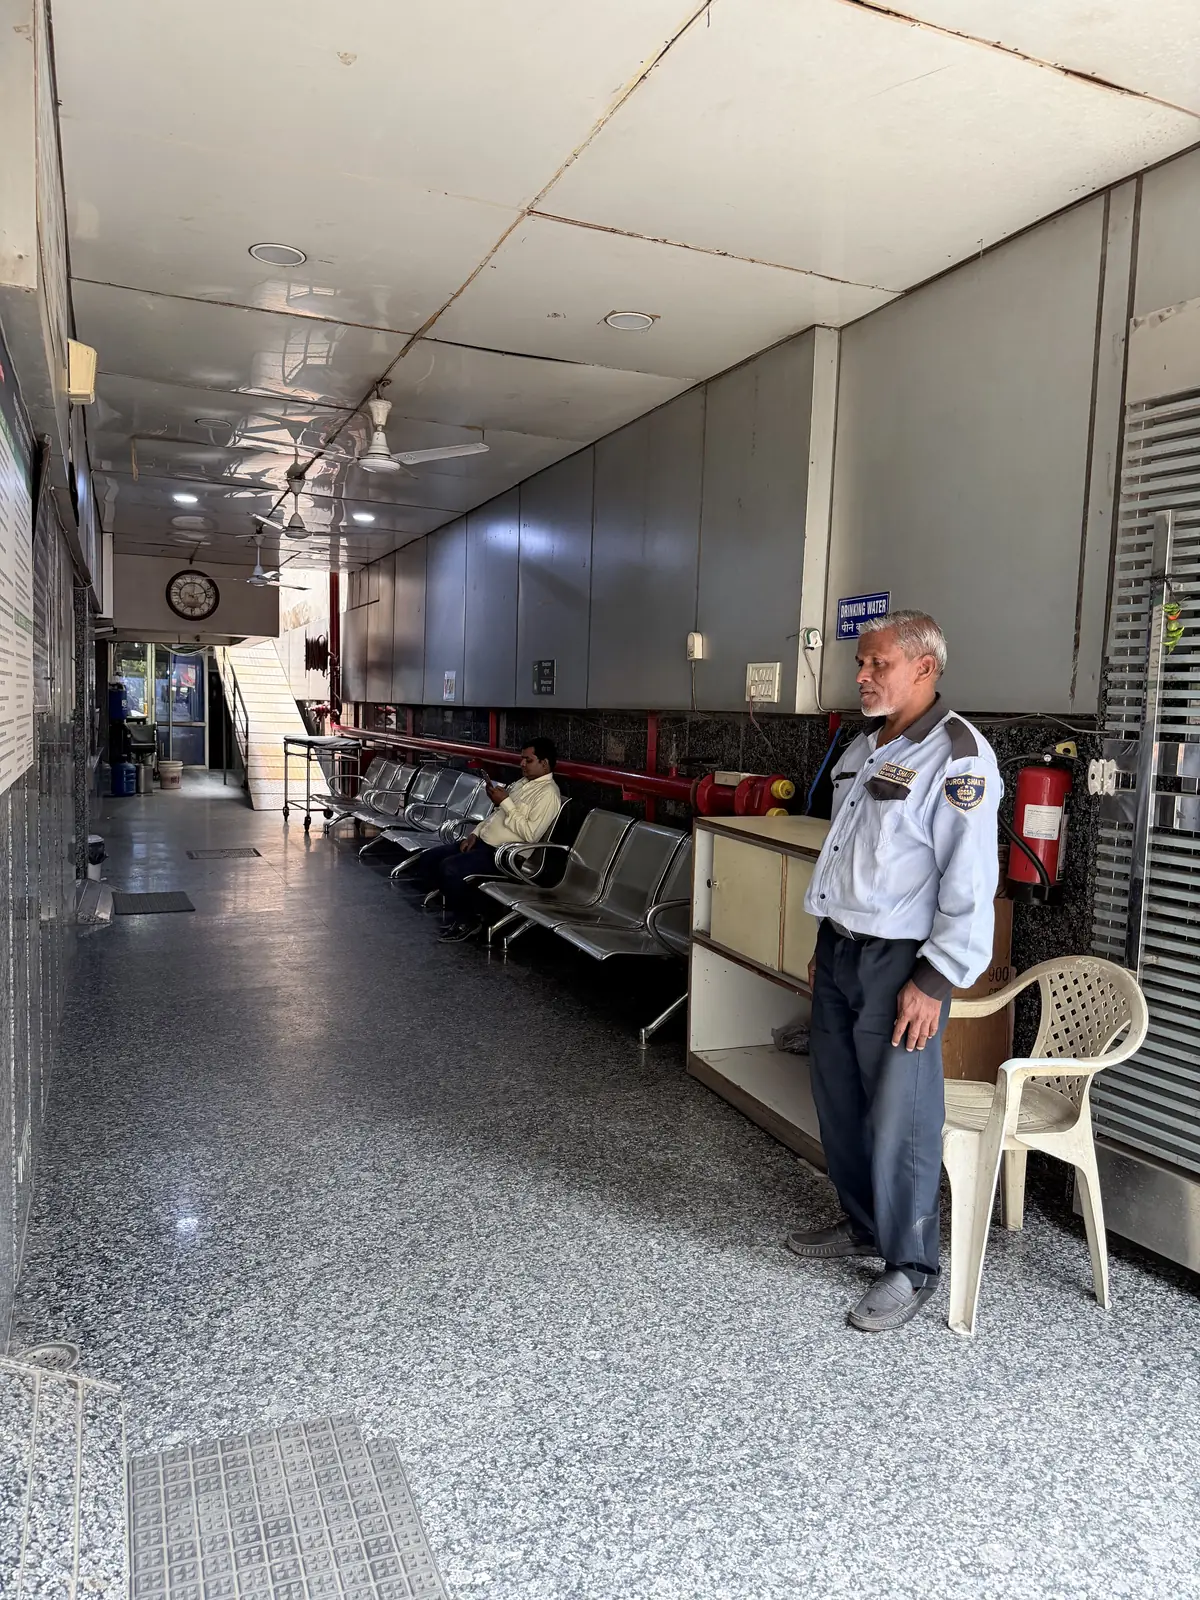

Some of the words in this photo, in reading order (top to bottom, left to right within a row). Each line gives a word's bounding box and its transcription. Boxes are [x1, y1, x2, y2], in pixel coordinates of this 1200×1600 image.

[841, 602, 866, 618] DRINKING
[867, 599, 887, 615] WATER
[841, 620, 854, 633] पीने
[945, 778, 966, 786] DURGA
[988, 966, 1009, 982] 900
